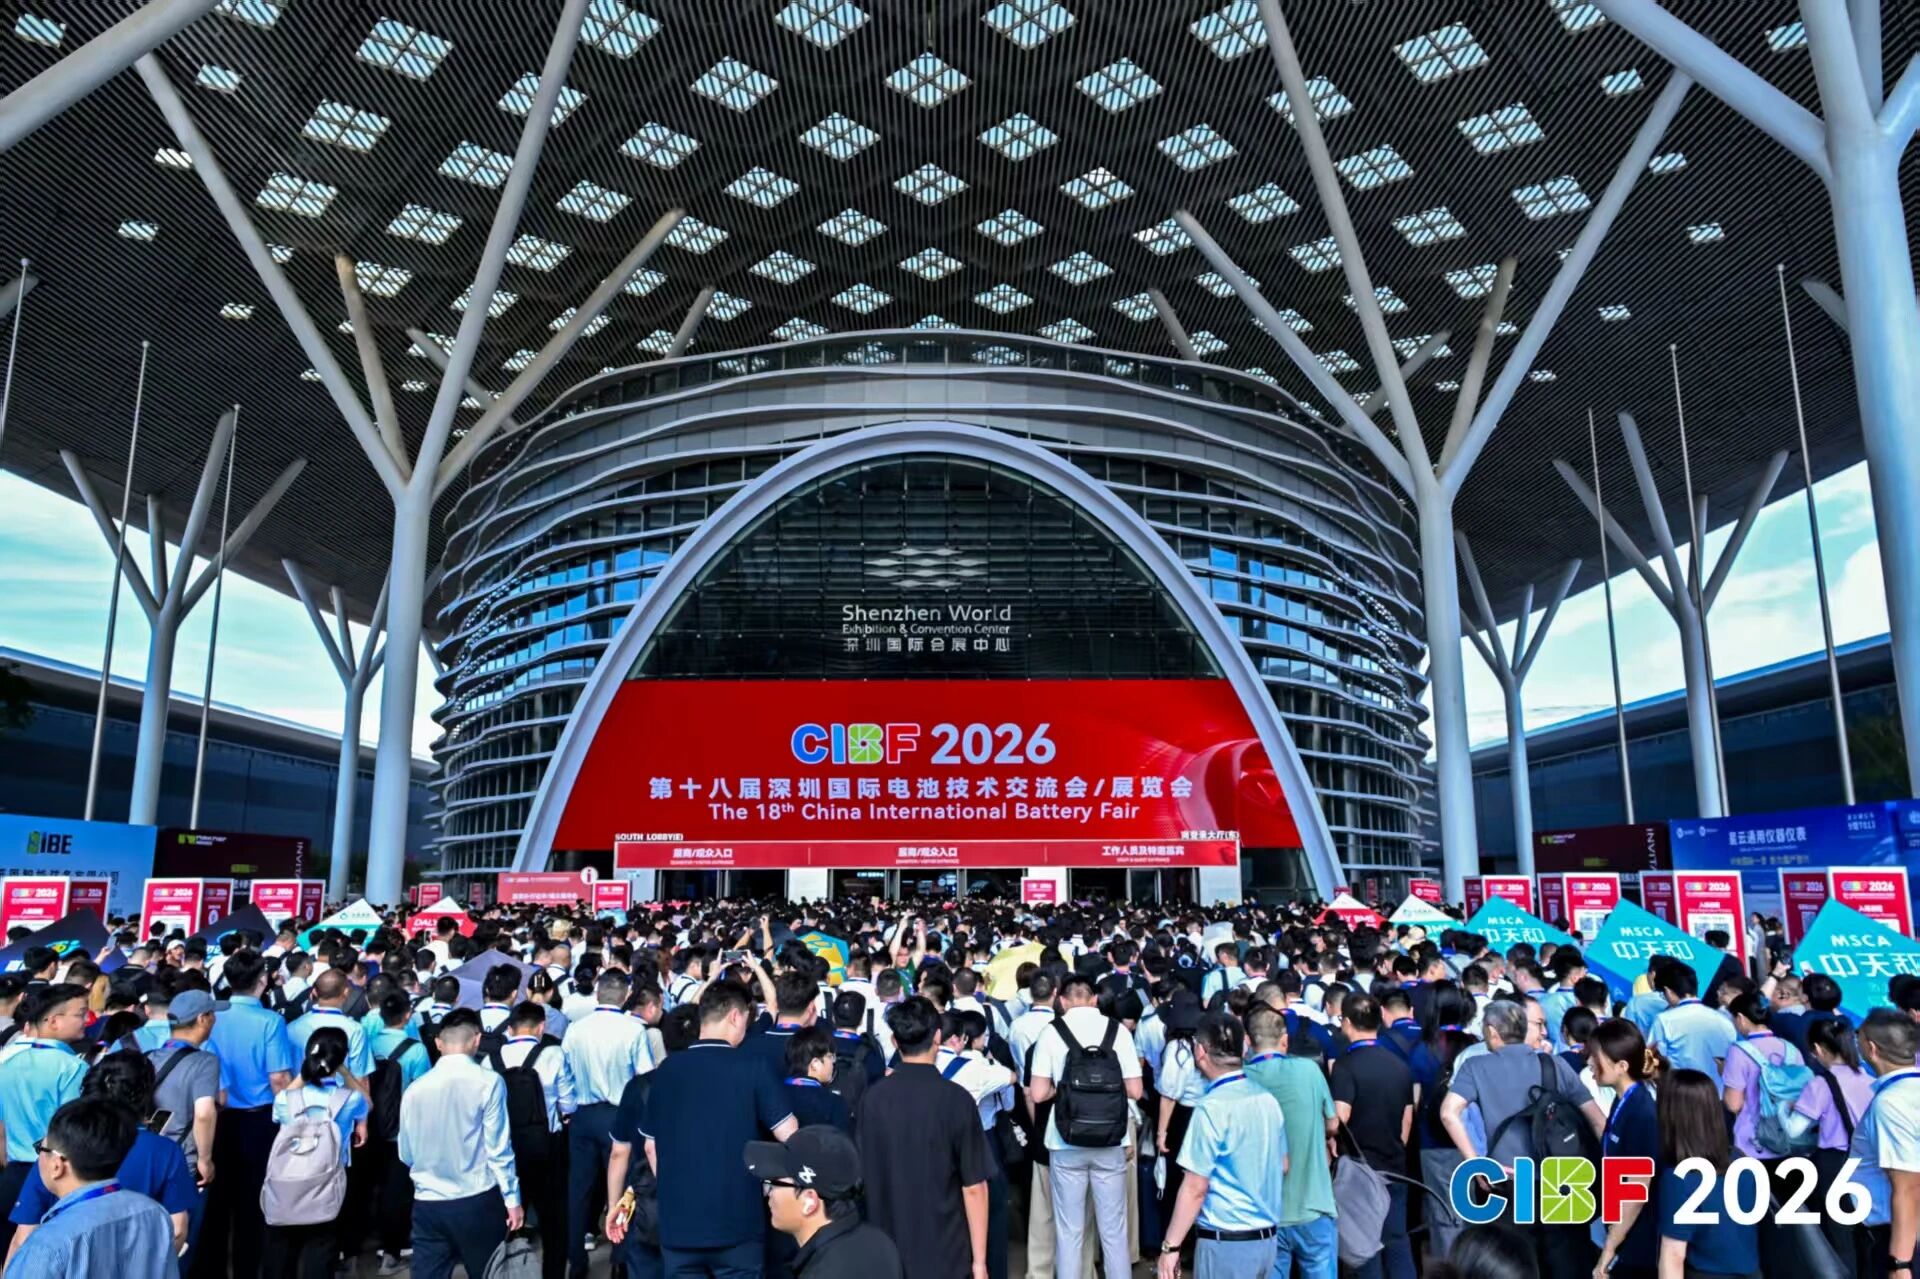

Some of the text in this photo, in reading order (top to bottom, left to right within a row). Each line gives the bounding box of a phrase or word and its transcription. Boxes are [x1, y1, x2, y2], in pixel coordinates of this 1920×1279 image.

[842, 604, 1011, 621] Shenzhen World
[842, 624, 1010, 634] Exhibition & Convention Center
[843, 637, 1010, 651] 深圳国际会展中心
[791, 723, 1056, 764] CIBF 2026
[649, 777, 1193, 799] 第十八届深圳国际电池技术交流会/展览会
[708, 803, 1140, 824] The 18th China International Battery Fair
[615, 833, 643, 841] SOUTH
[1868, 880, 1895, 891] 2026
[1487, 916, 1524, 926] MSCA
[1619, 926, 1664, 937] MSCA
[1830, 934, 1892, 947] MSCA
